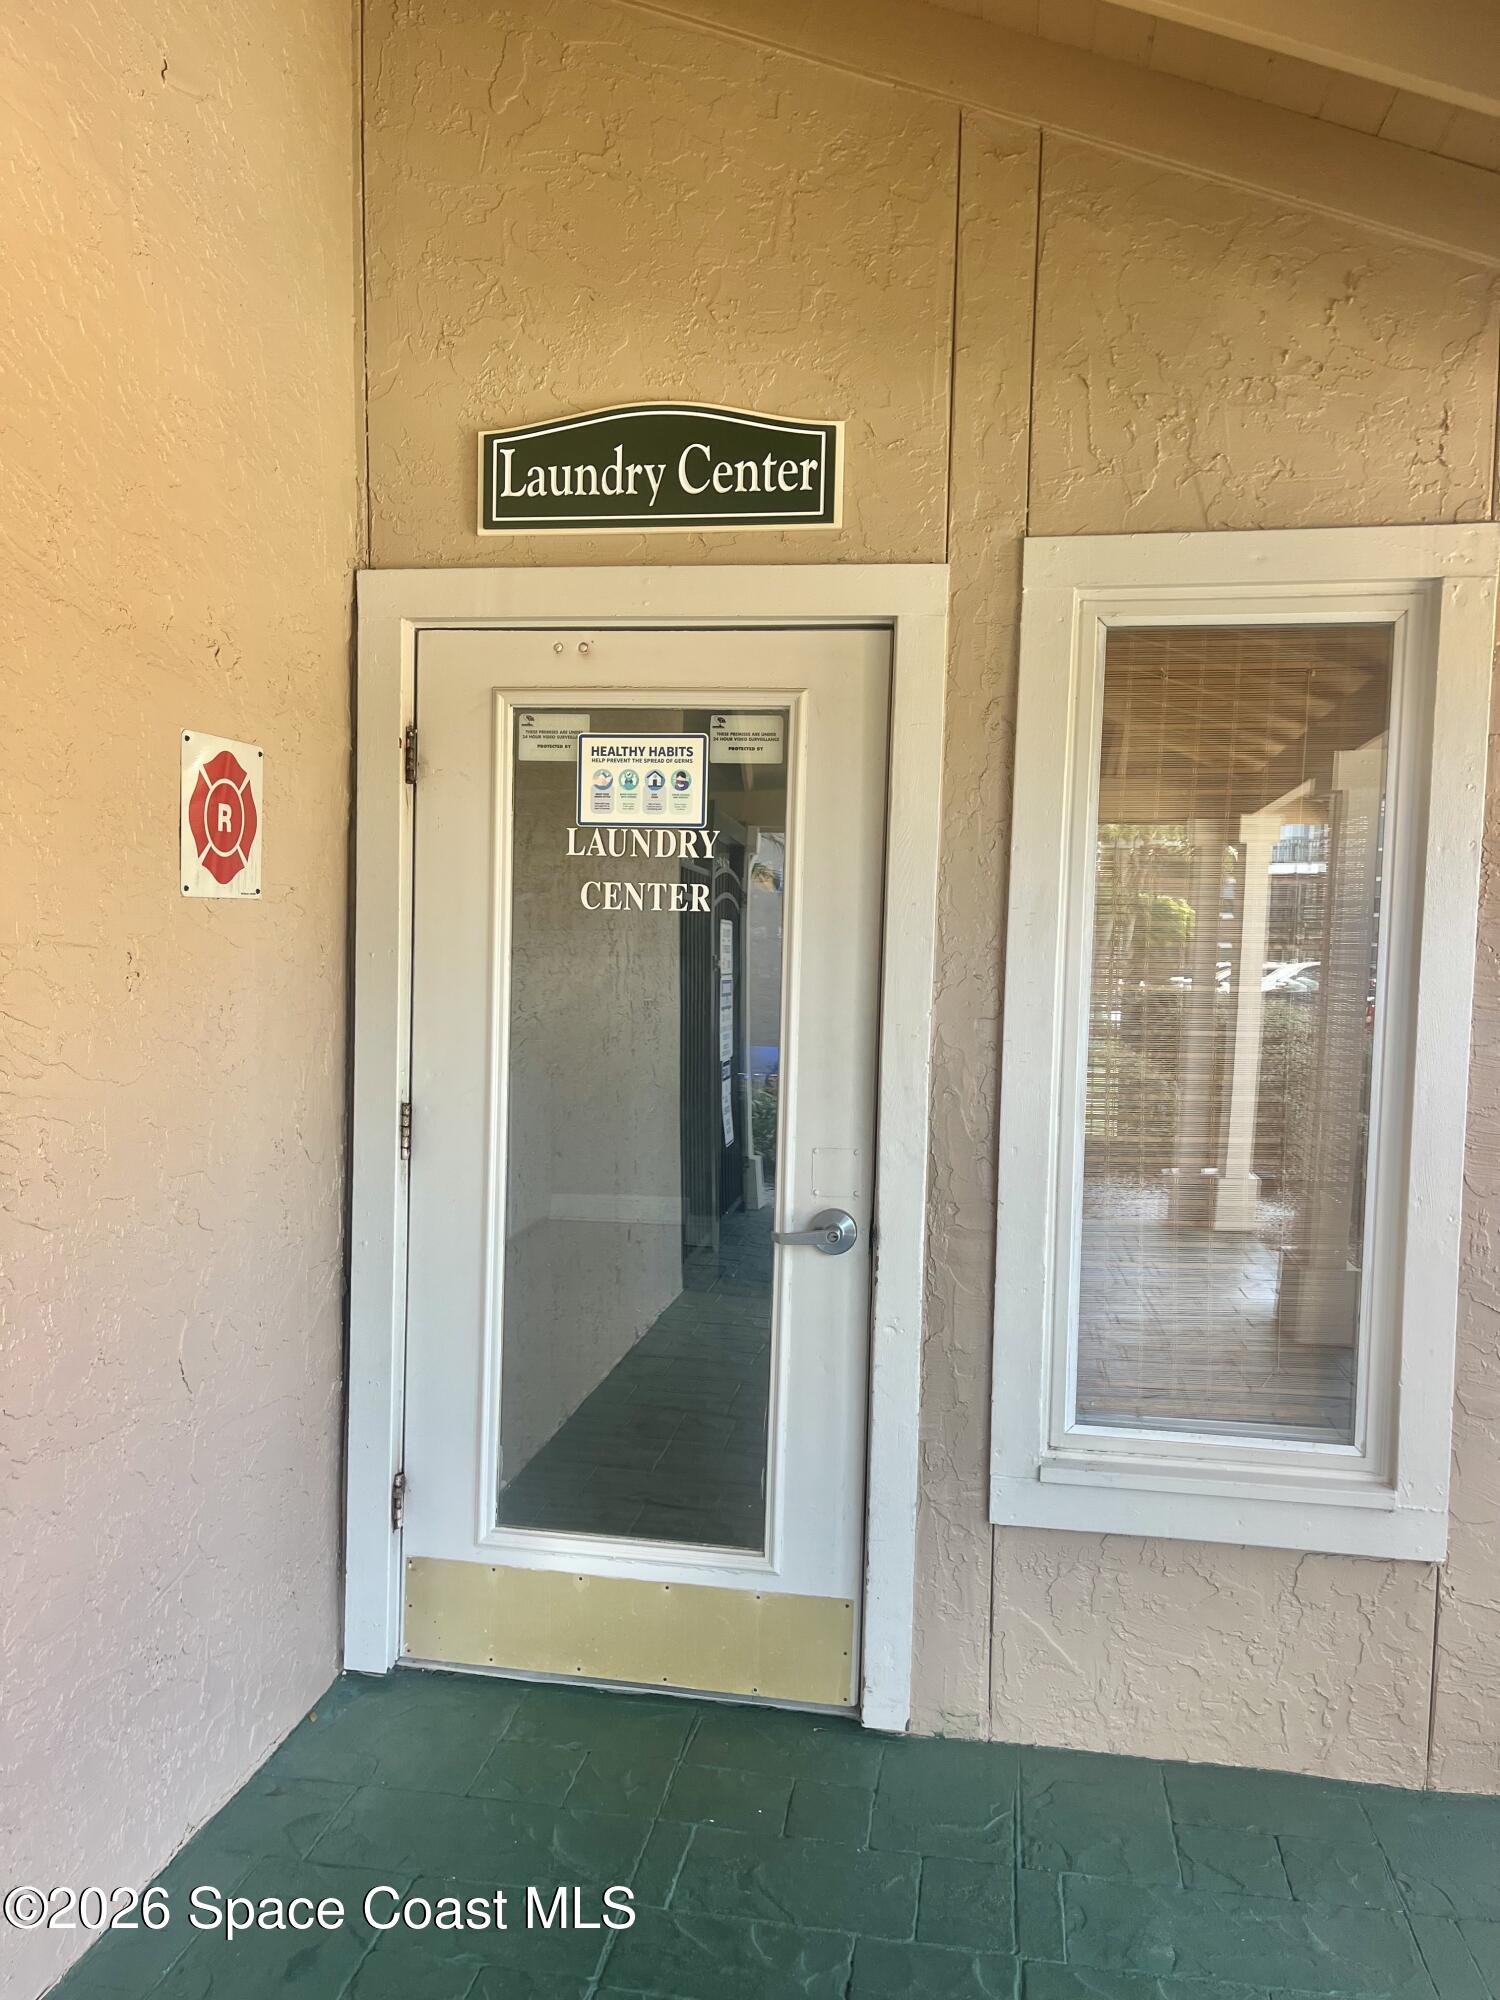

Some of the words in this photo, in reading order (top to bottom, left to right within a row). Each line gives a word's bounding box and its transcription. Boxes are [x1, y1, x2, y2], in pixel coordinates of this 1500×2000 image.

[500, 443, 667, 507] Laundry
[678, 443, 818, 494] Center
[591, 746, 645, 757] HEALTHY
[649, 746, 693, 757] HABITS
[217, 803, 233, 833] R
[566, 827, 721, 859] LAUNDRY
[580, 881, 711, 912] CENTER
